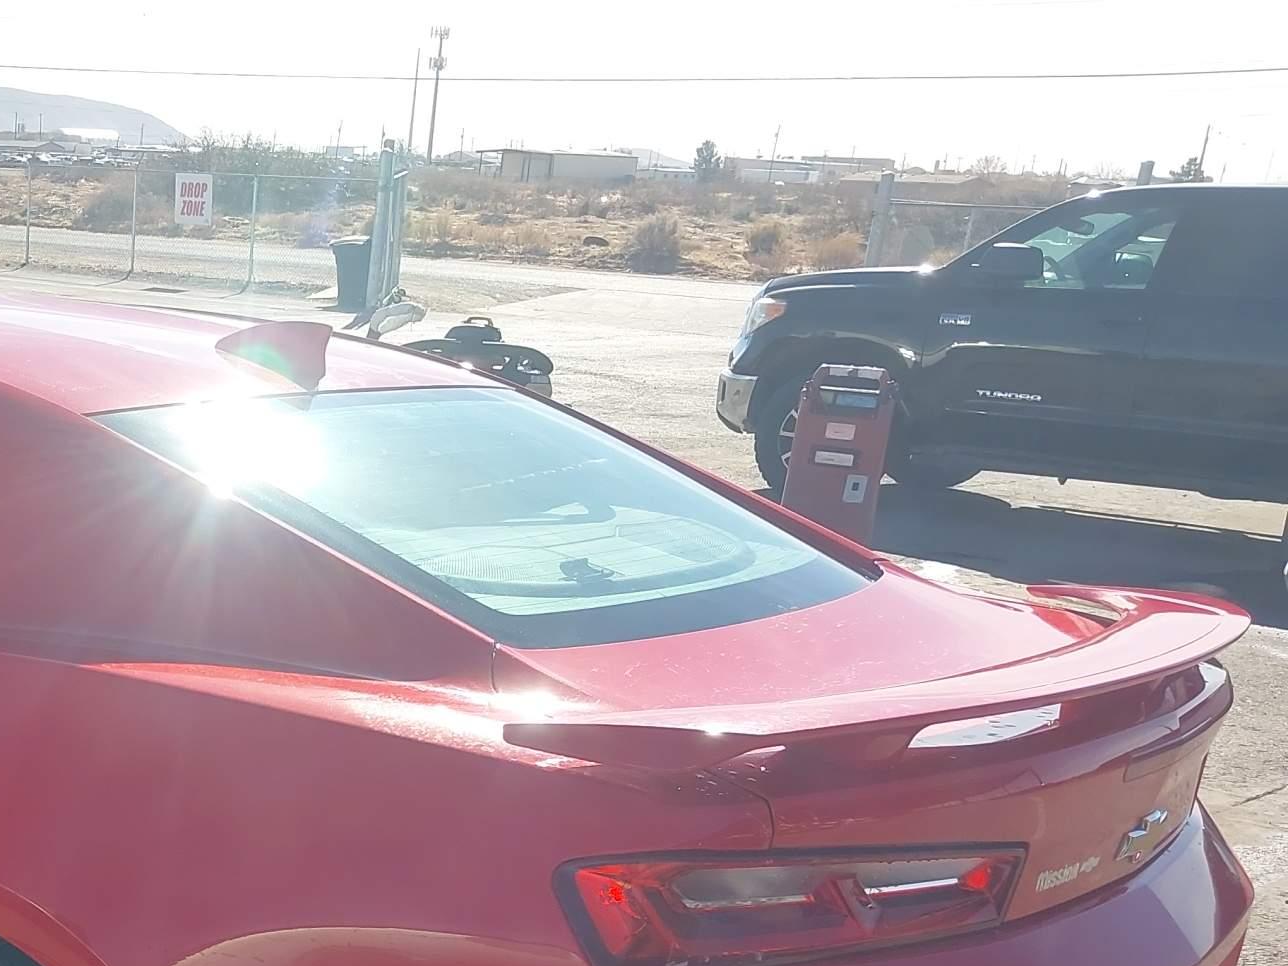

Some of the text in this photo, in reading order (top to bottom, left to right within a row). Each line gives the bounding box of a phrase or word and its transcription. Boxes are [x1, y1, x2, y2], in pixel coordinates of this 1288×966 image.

[180, 182, 208, 198] DROP
[180, 200, 206, 217] ZONE
[976, 389, 1042, 402] TUNDRA
